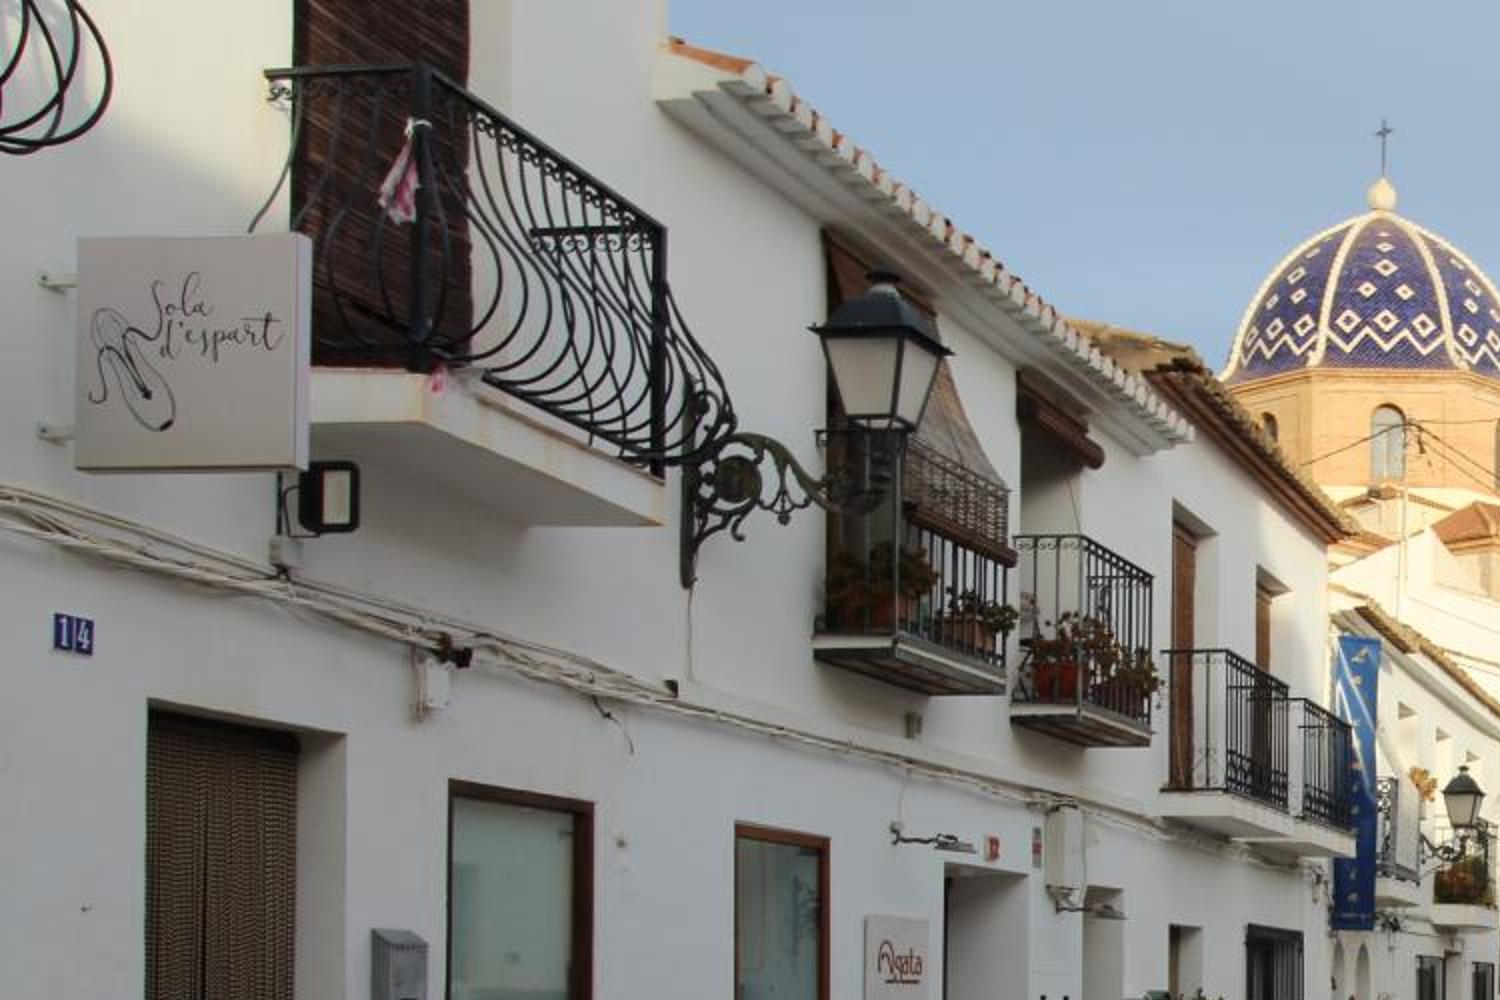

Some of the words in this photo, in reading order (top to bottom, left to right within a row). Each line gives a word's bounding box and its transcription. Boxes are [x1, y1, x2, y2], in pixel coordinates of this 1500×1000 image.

[149, 271, 214, 336] Sola
[160, 312, 284, 363] d'espart
[58, 616, 91, 650] 14
